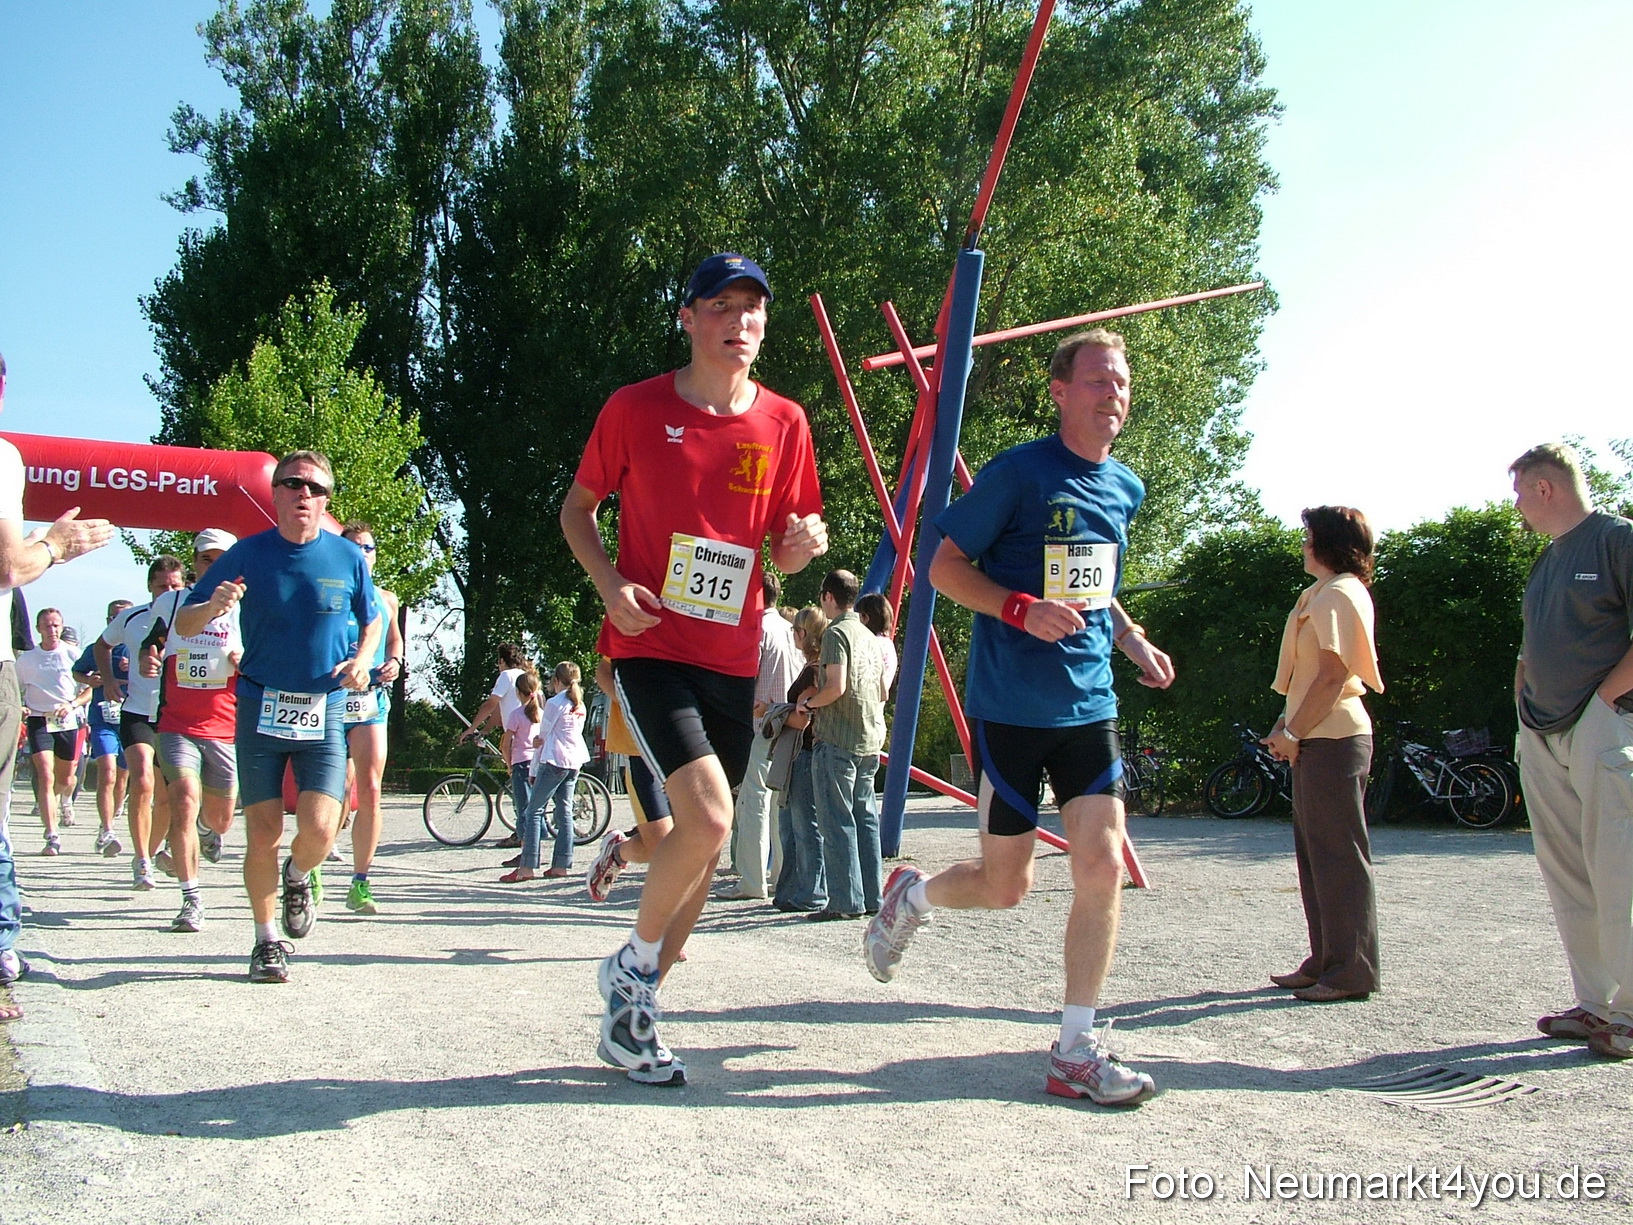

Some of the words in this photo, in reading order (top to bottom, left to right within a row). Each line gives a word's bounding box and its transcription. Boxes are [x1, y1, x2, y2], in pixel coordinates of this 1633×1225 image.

[25, 466, 81, 491] ung
[90, 466, 218, 496] LGS-Park
[695, 546, 746, 570] Christian
[1067, 545, 1093, 557] Hans
[673, 563, 684, 575] C
[690, 572, 733, 601] 315
[1050, 564, 1060, 575] B
[1069, 567, 1102, 589] 250
[190, 666, 207, 678] 86
[278, 693, 312, 705] Helmut
[264, 704, 272, 713] B
[276, 709, 320, 728] 2269
